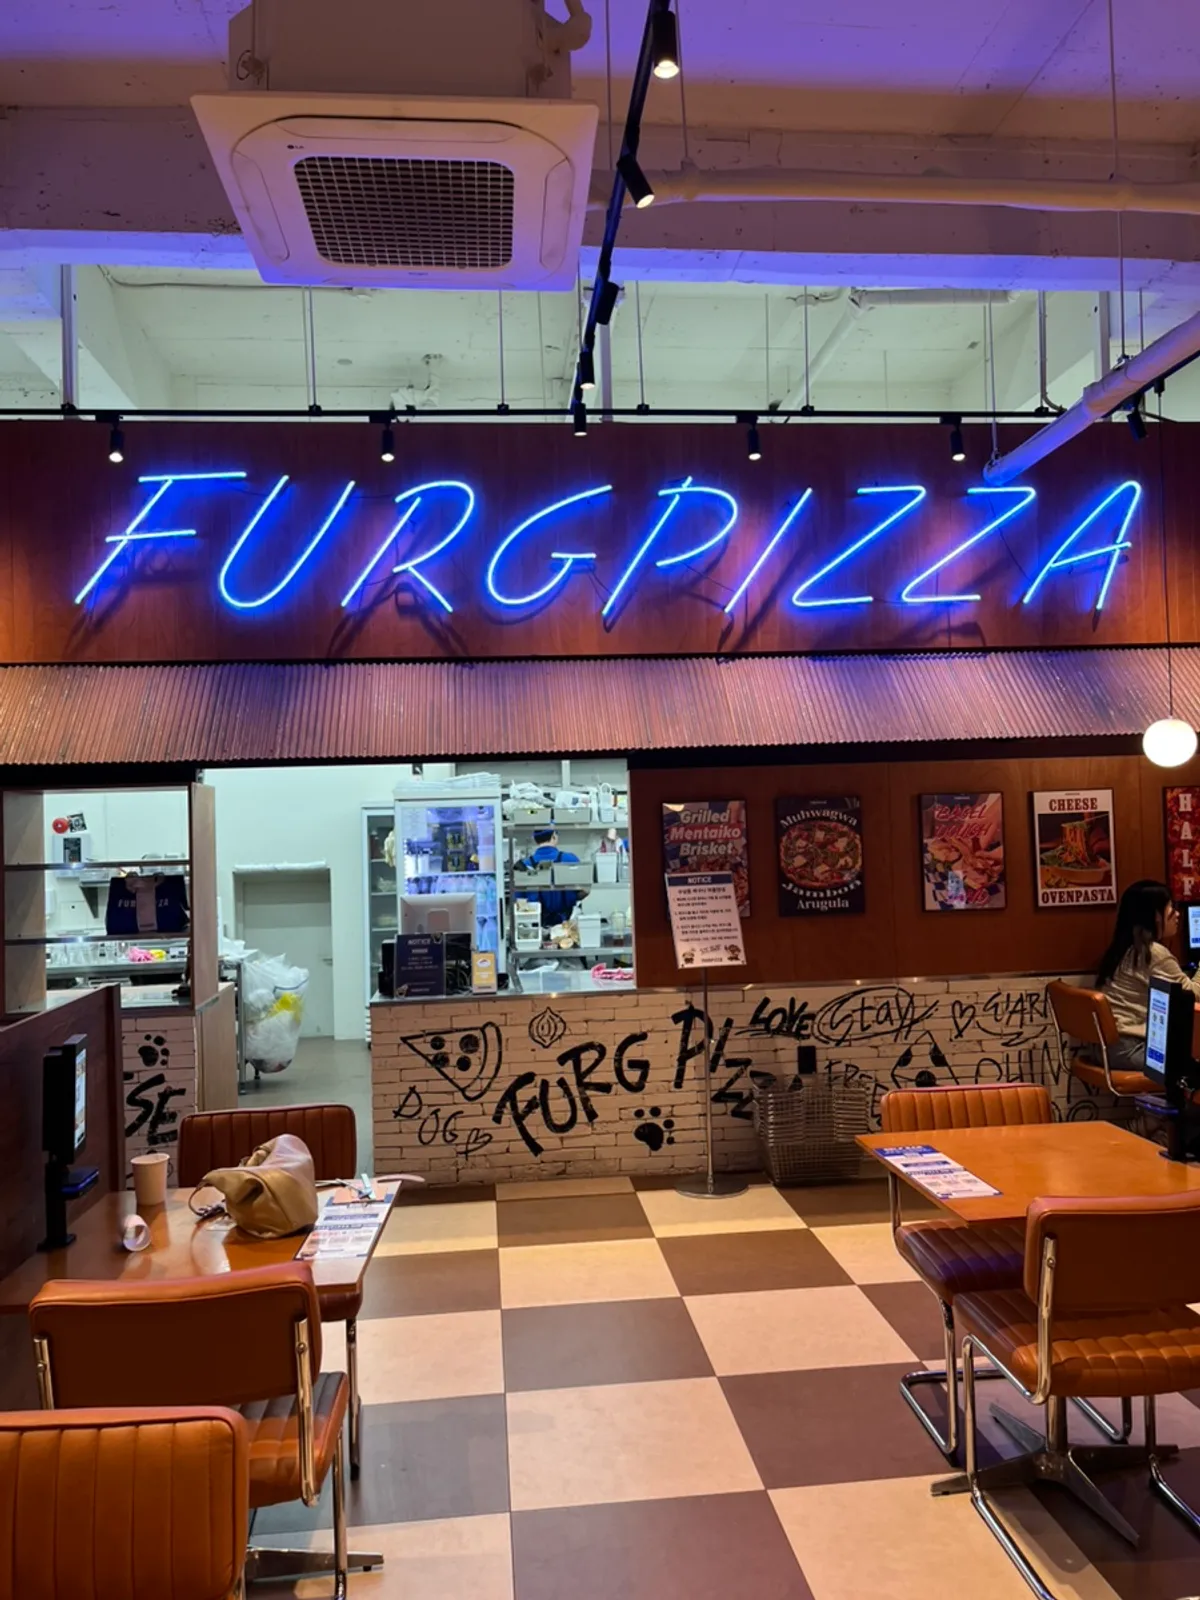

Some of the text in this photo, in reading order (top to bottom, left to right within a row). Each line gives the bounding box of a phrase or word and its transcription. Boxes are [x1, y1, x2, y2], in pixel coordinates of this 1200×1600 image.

[74, 471, 1143, 616] FURGPIZZA
[1049, 797, 1098, 812] CHEESE
[680, 809, 731, 824] Grilled
[780, 808, 858, 828] Muhwagwa
[669, 825, 741, 840] Mentaiko
[680, 841, 733, 856] Brisket
[797, 897, 850, 911] Arugula
[1041, 889, 1114, 904] OVENPASTA
[749, 997, 816, 1041] LOVE
[492, 1031, 650, 1158] FURG
[392, 1085, 464, 1145] DOG
